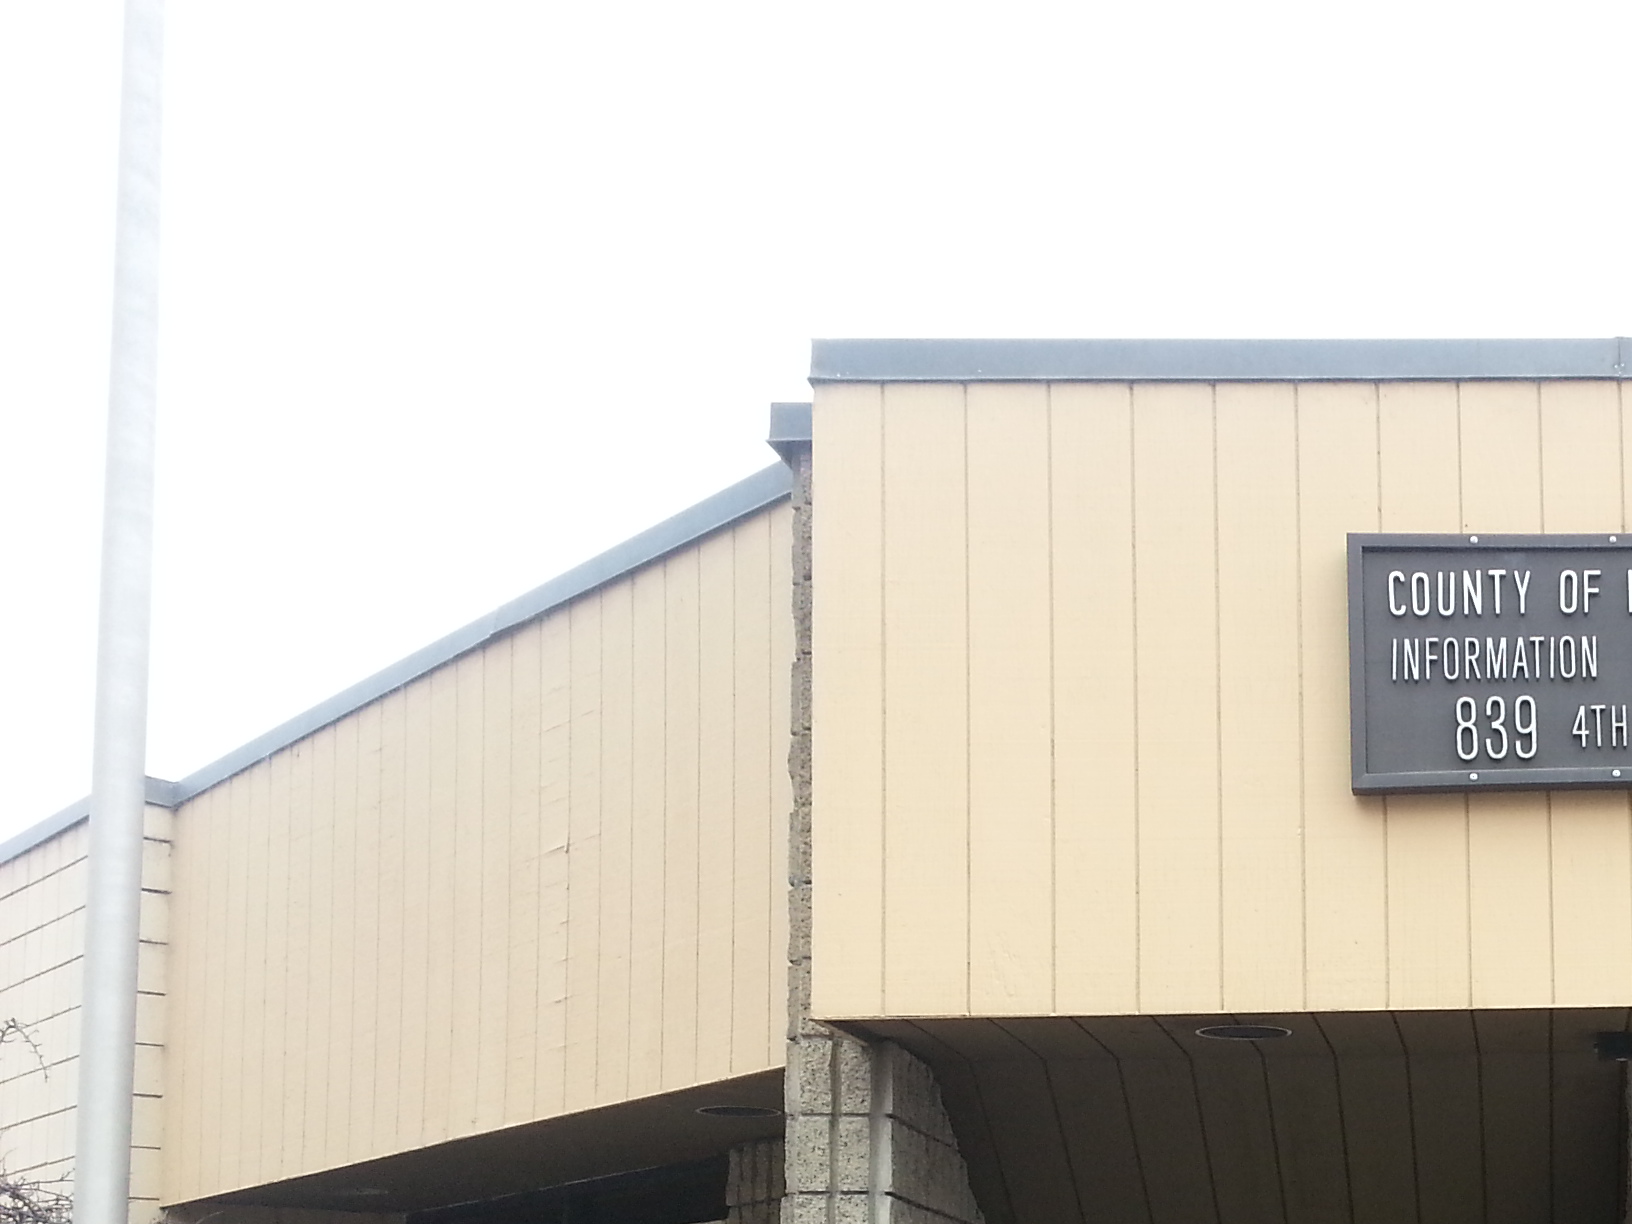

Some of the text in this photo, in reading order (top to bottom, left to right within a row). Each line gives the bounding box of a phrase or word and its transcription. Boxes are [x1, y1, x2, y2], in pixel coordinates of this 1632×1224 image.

[1388, 569, 1531, 616] COUNTY
[1559, 569, 1602, 614] OF
[1392, 635, 1598, 681] INFORMATION
[1456, 694, 1538, 760] 839
[1572, 704, 1628, 748] 4TH
